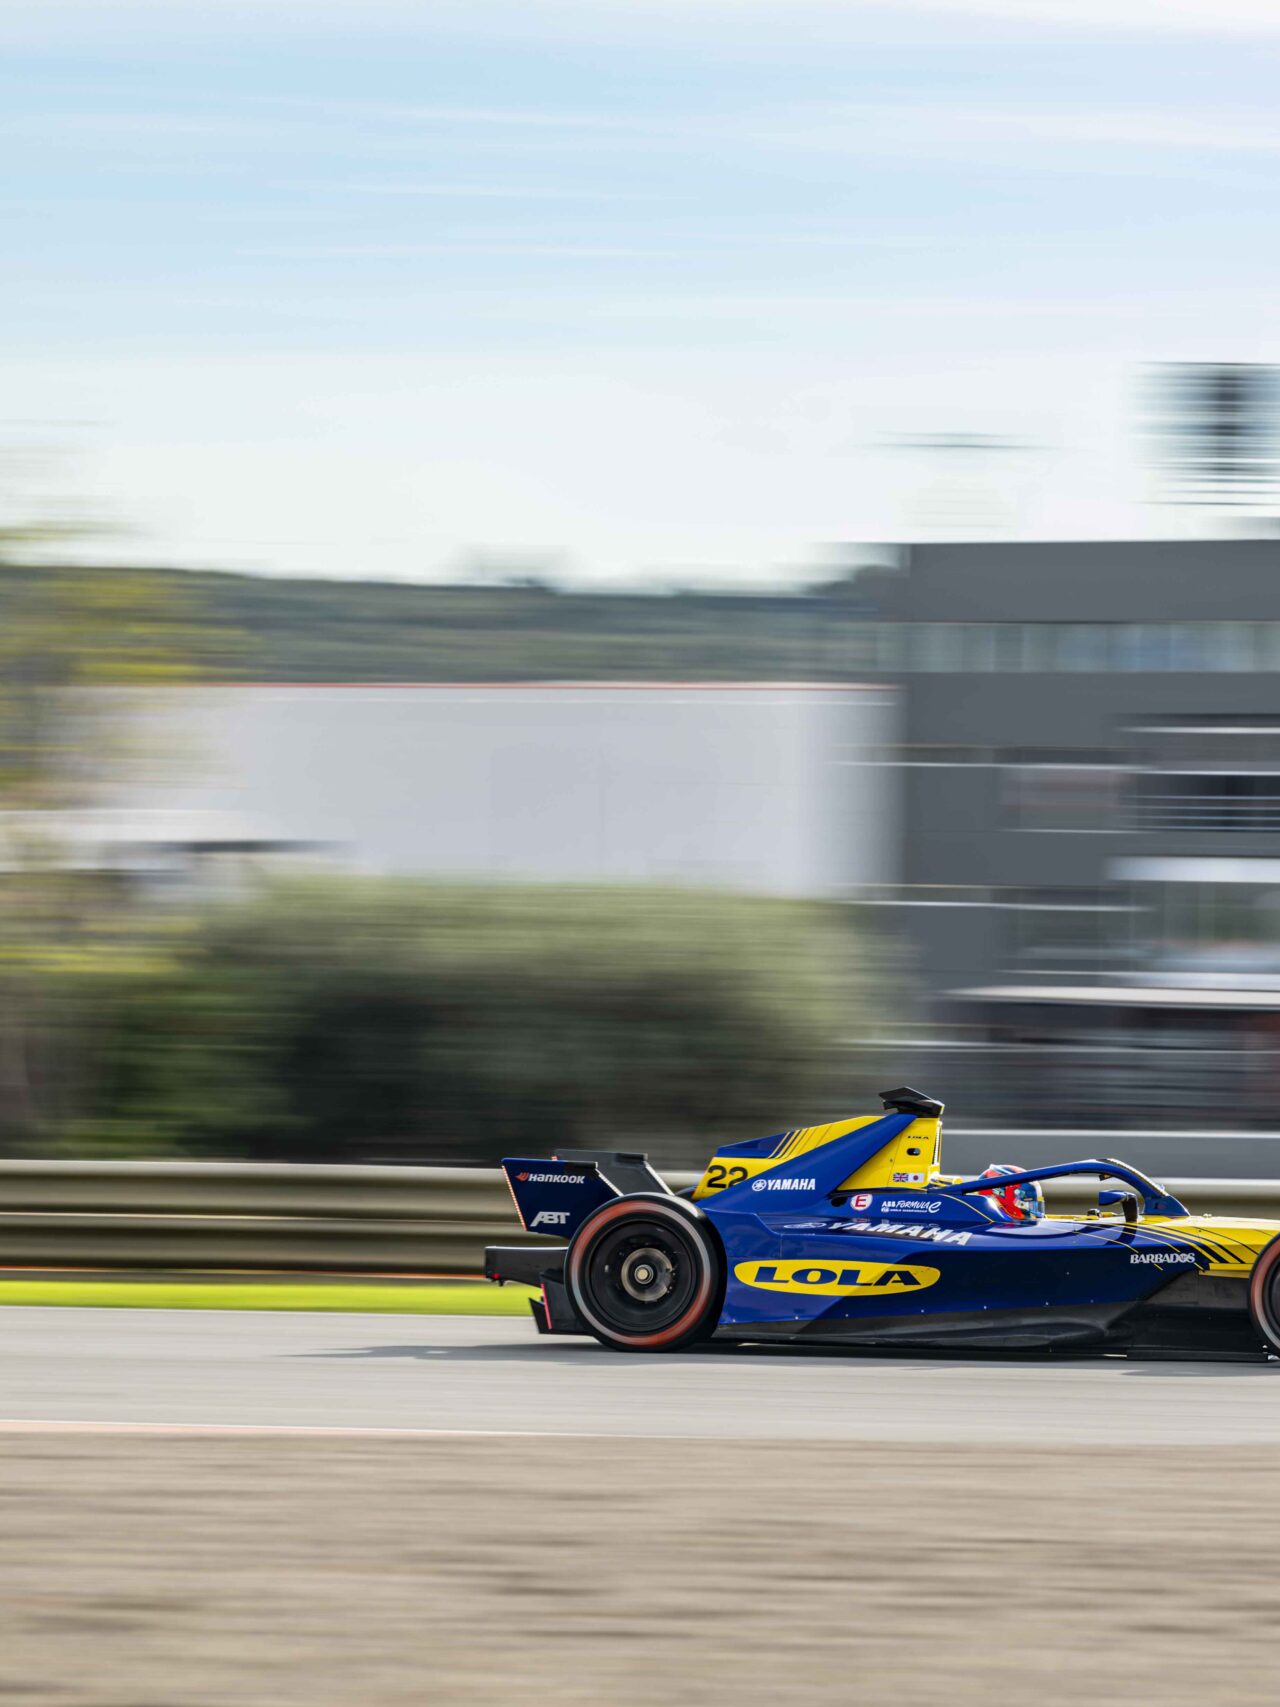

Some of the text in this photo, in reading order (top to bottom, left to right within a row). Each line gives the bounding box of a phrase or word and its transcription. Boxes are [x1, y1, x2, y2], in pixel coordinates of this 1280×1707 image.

[706, 1165, 748, 1189] 22
[767, 1178, 816, 1191] YAMAHA
[896, 1200, 931, 1209] FORMULA
[530, 1211, 570, 1227] ABT
[828, 1222, 973, 1246] YAMAHA
[1130, 1253, 1195, 1264] BARBADOS
[754, 1267, 921, 1286] LOLA
